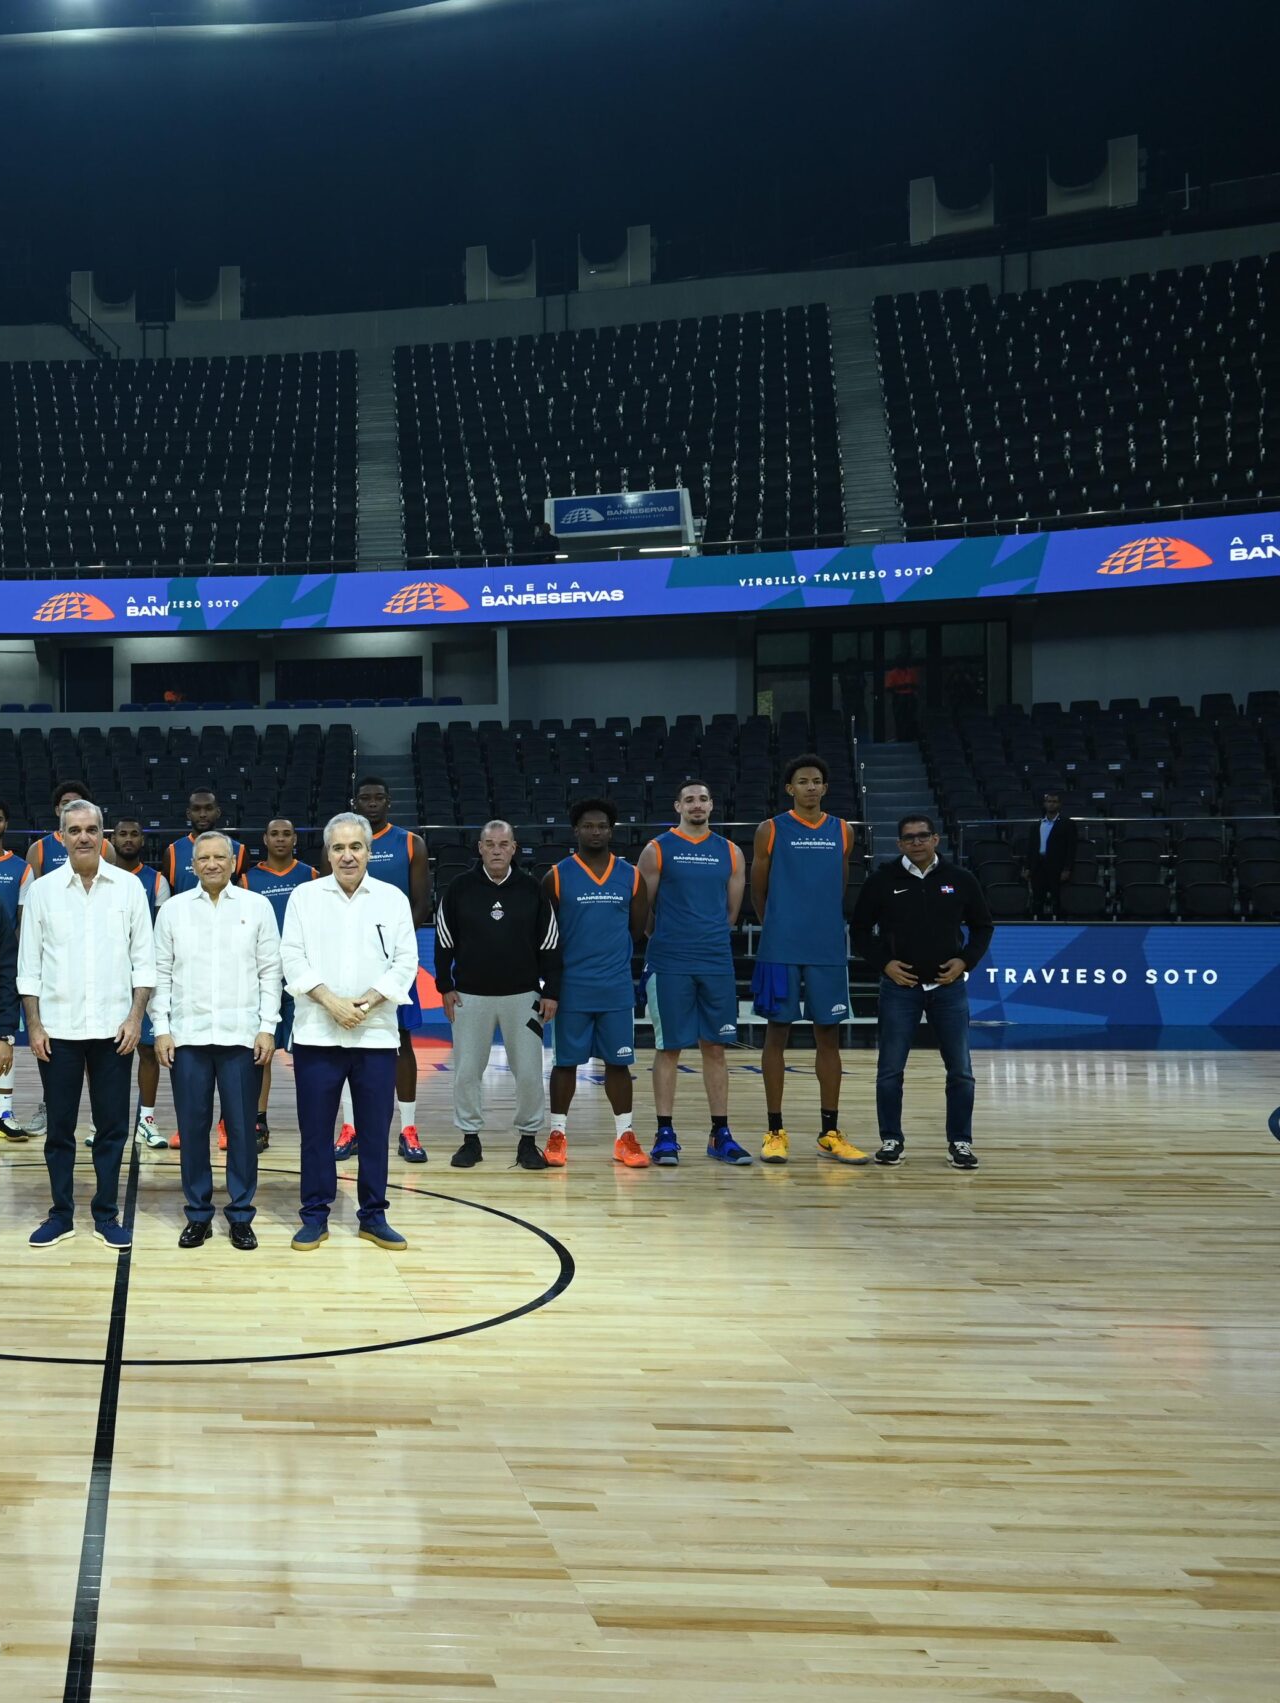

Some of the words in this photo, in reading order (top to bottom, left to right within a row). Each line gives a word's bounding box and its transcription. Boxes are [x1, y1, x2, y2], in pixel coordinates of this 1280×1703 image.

[606, 505, 674, 515] BANRESERVAS
[739, 575, 807, 587] VIRGILIO
[813, 569, 887, 583] TRAVIESO
[894, 566, 934, 578] SOTO
[482, 581, 580, 594] ARENA
[207, 600, 239, 608] SOTO
[481, 589, 625, 607] BANRESERVAS
[986, 968, 1128, 985] TRAVIESO
[1145, 969, 1218, 985] SOTO
